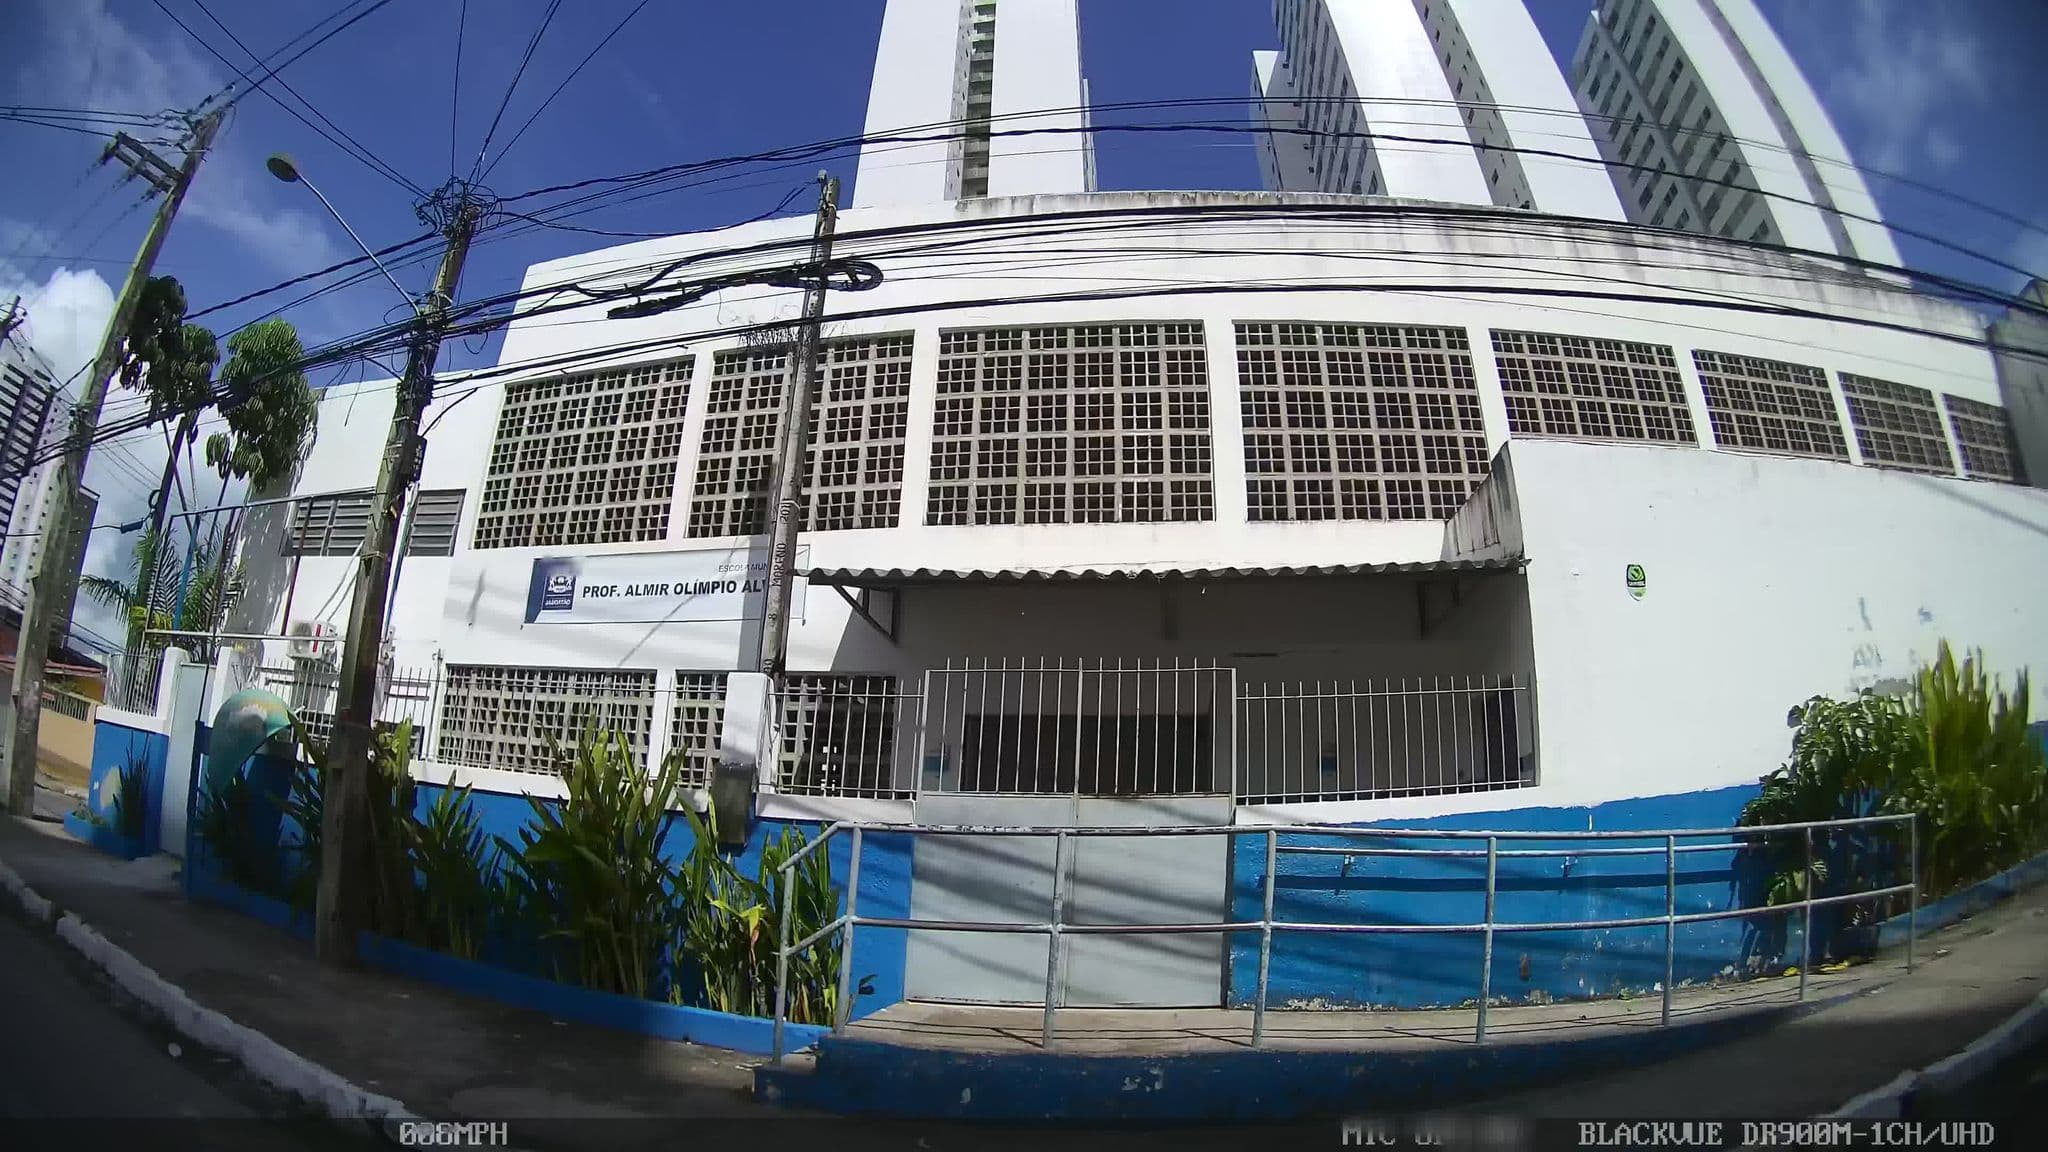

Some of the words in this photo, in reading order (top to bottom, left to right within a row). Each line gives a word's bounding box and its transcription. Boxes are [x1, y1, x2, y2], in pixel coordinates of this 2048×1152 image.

[582, 585, 620, 598] PROF.
[625, 583, 669, 597] ALMIR
[673, 579, 736, 595] OLÍMPIO
